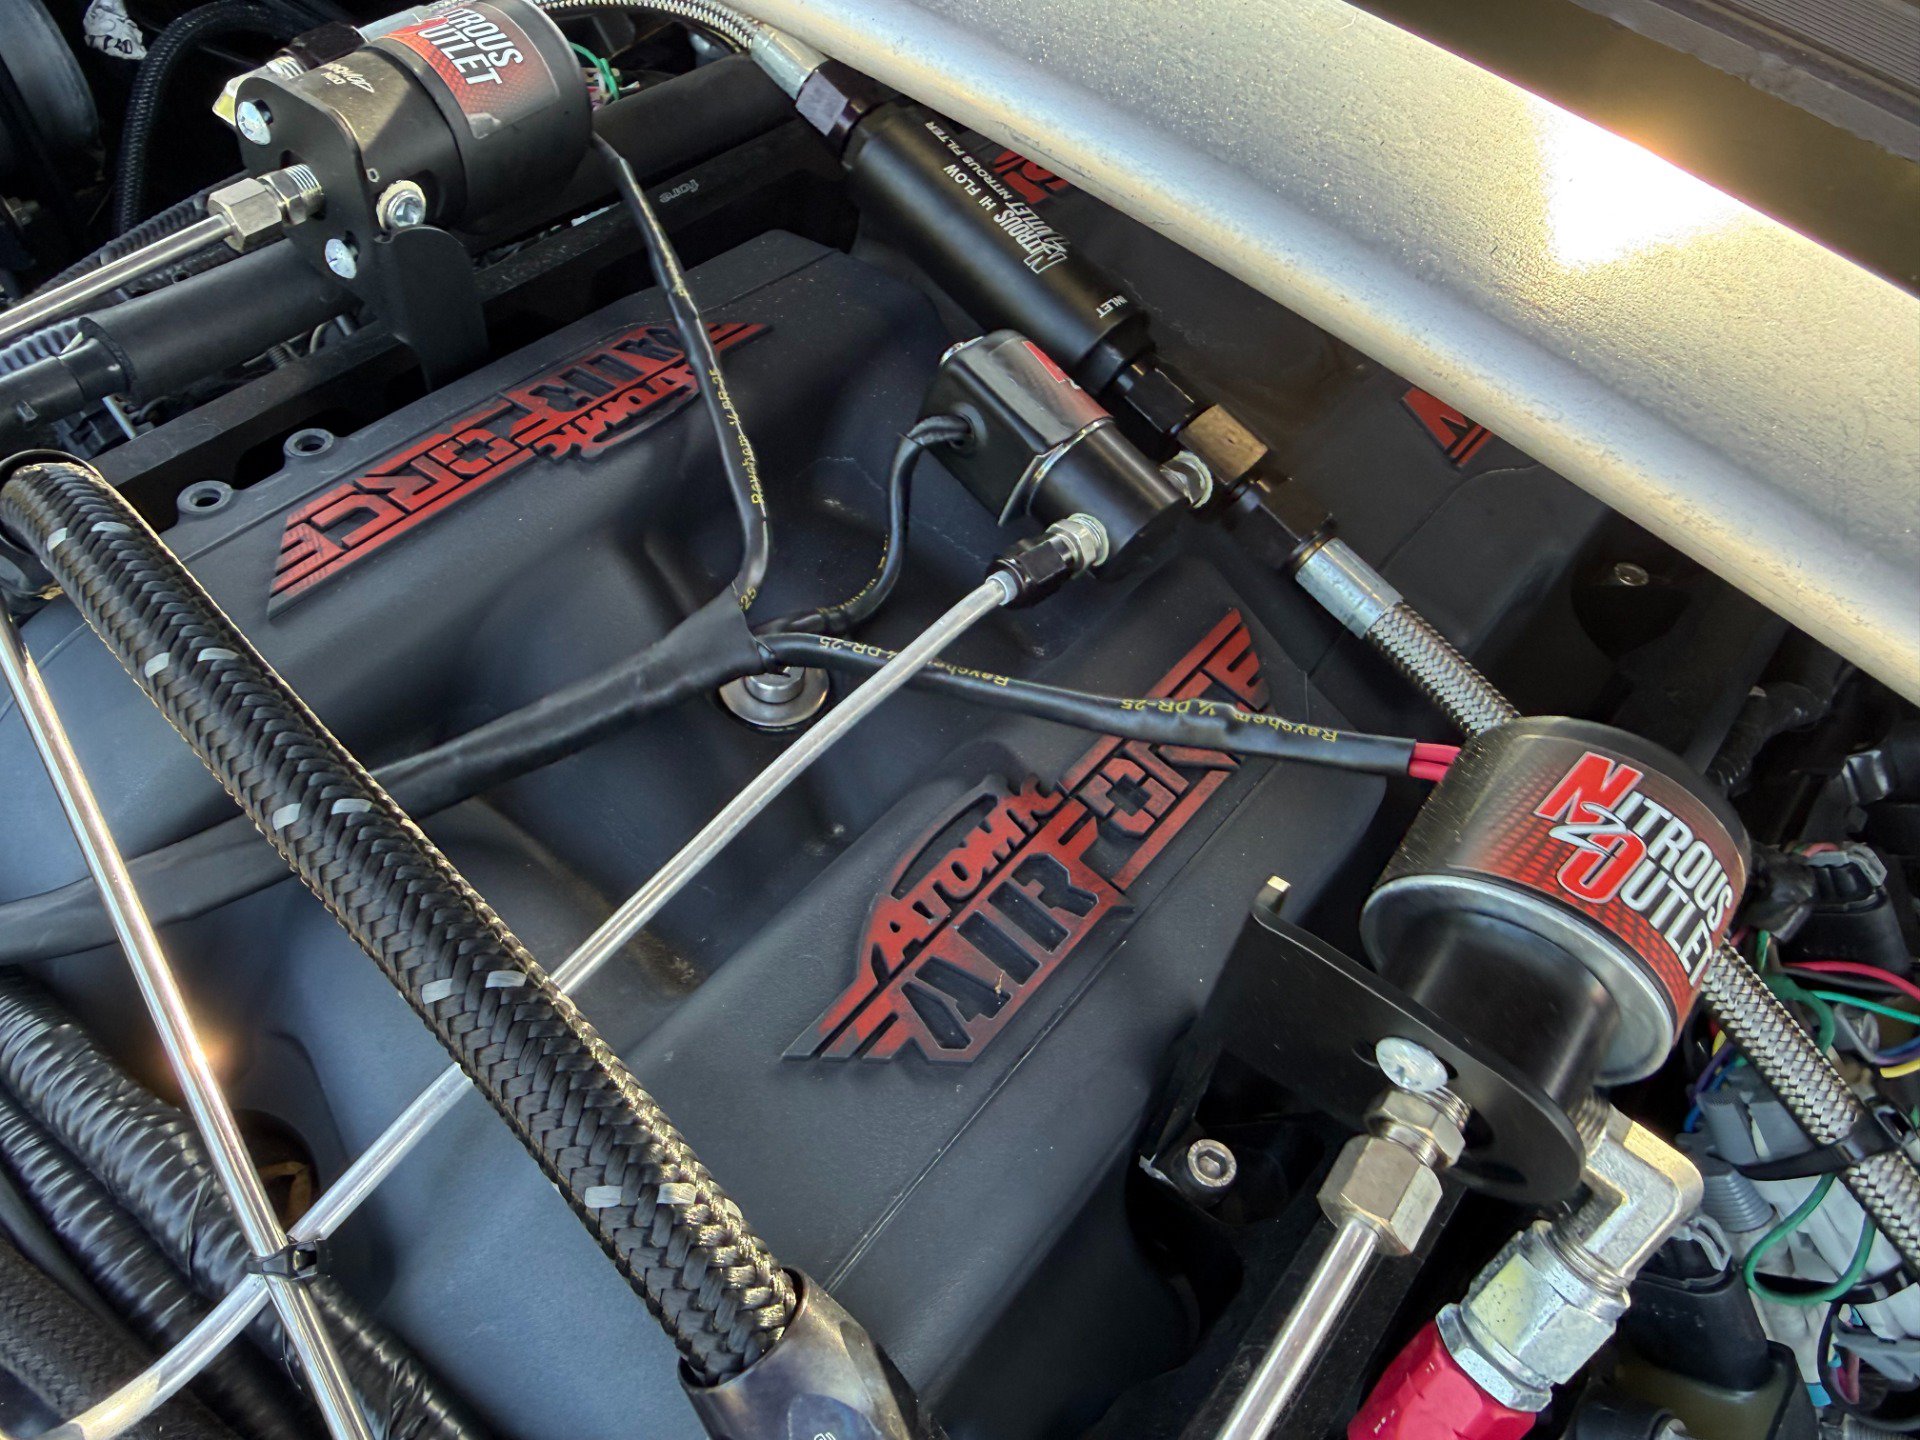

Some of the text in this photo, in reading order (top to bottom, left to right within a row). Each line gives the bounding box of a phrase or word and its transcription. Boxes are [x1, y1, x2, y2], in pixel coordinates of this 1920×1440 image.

[924, 120, 966, 156] FILTER
[943, 164, 982, 196] FLOW
[962, 156, 1013, 201] NITROUS
[978, 195, 997, 211] HI
[1096, 295, 1128, 318] INLET
[819, 635, 882, 658] DR-25
[1119, 699, 1191, 714] DR-25
[1233, 713, 1339, 743] Raychem
[1533, 751, 1734, 932] NITROUS
[866, 773, 1064, 986] ATOMIC
[899, 851, 1101, 1050] AIR
